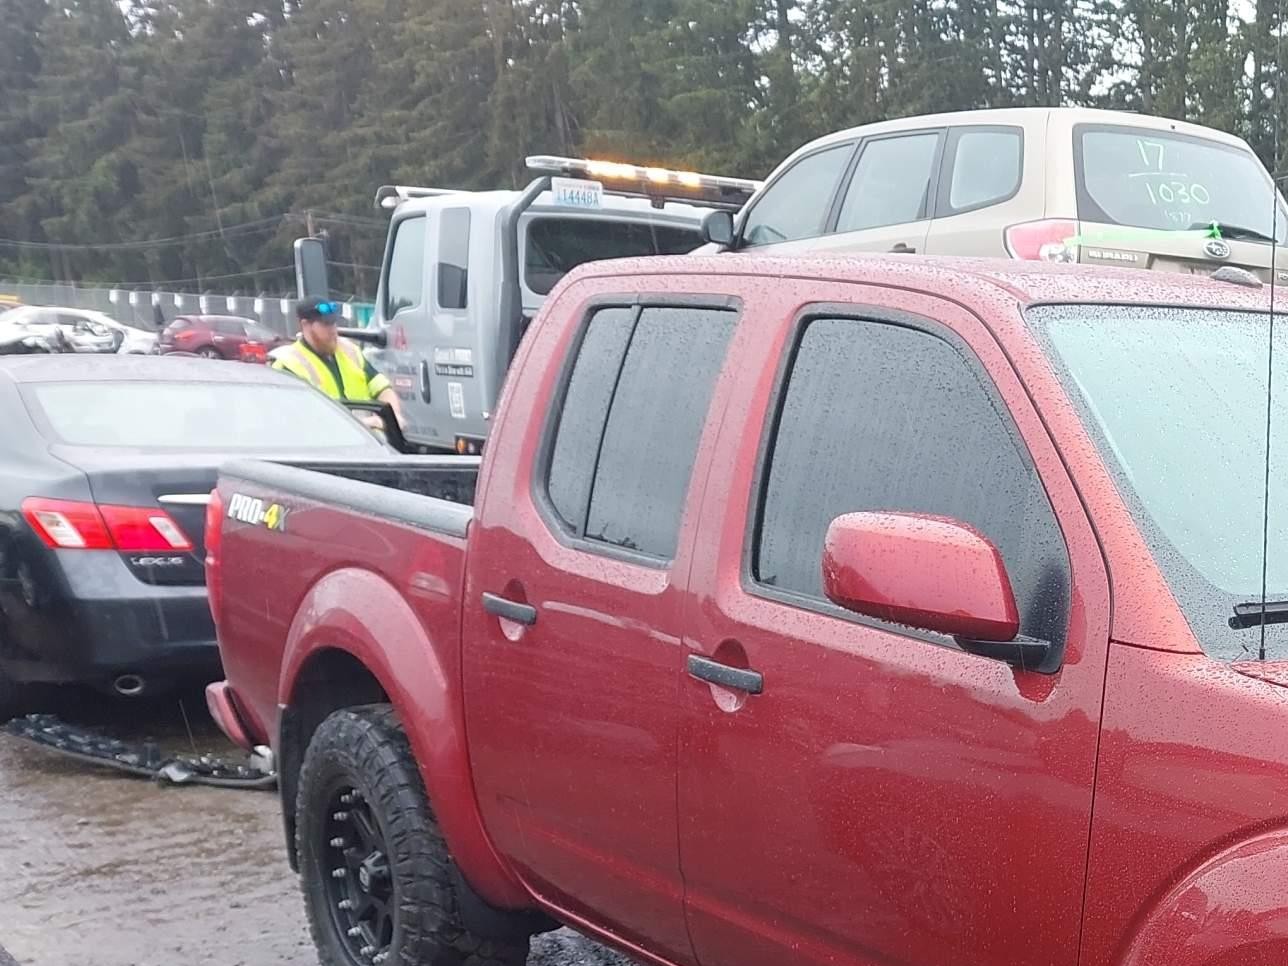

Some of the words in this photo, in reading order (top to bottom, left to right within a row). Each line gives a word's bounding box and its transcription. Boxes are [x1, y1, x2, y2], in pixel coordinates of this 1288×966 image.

[1136, 139, 1164, 170] 17
[1145, 181, 1210, 205] 1030
[228, 492, 290, 532] PRO-4X
